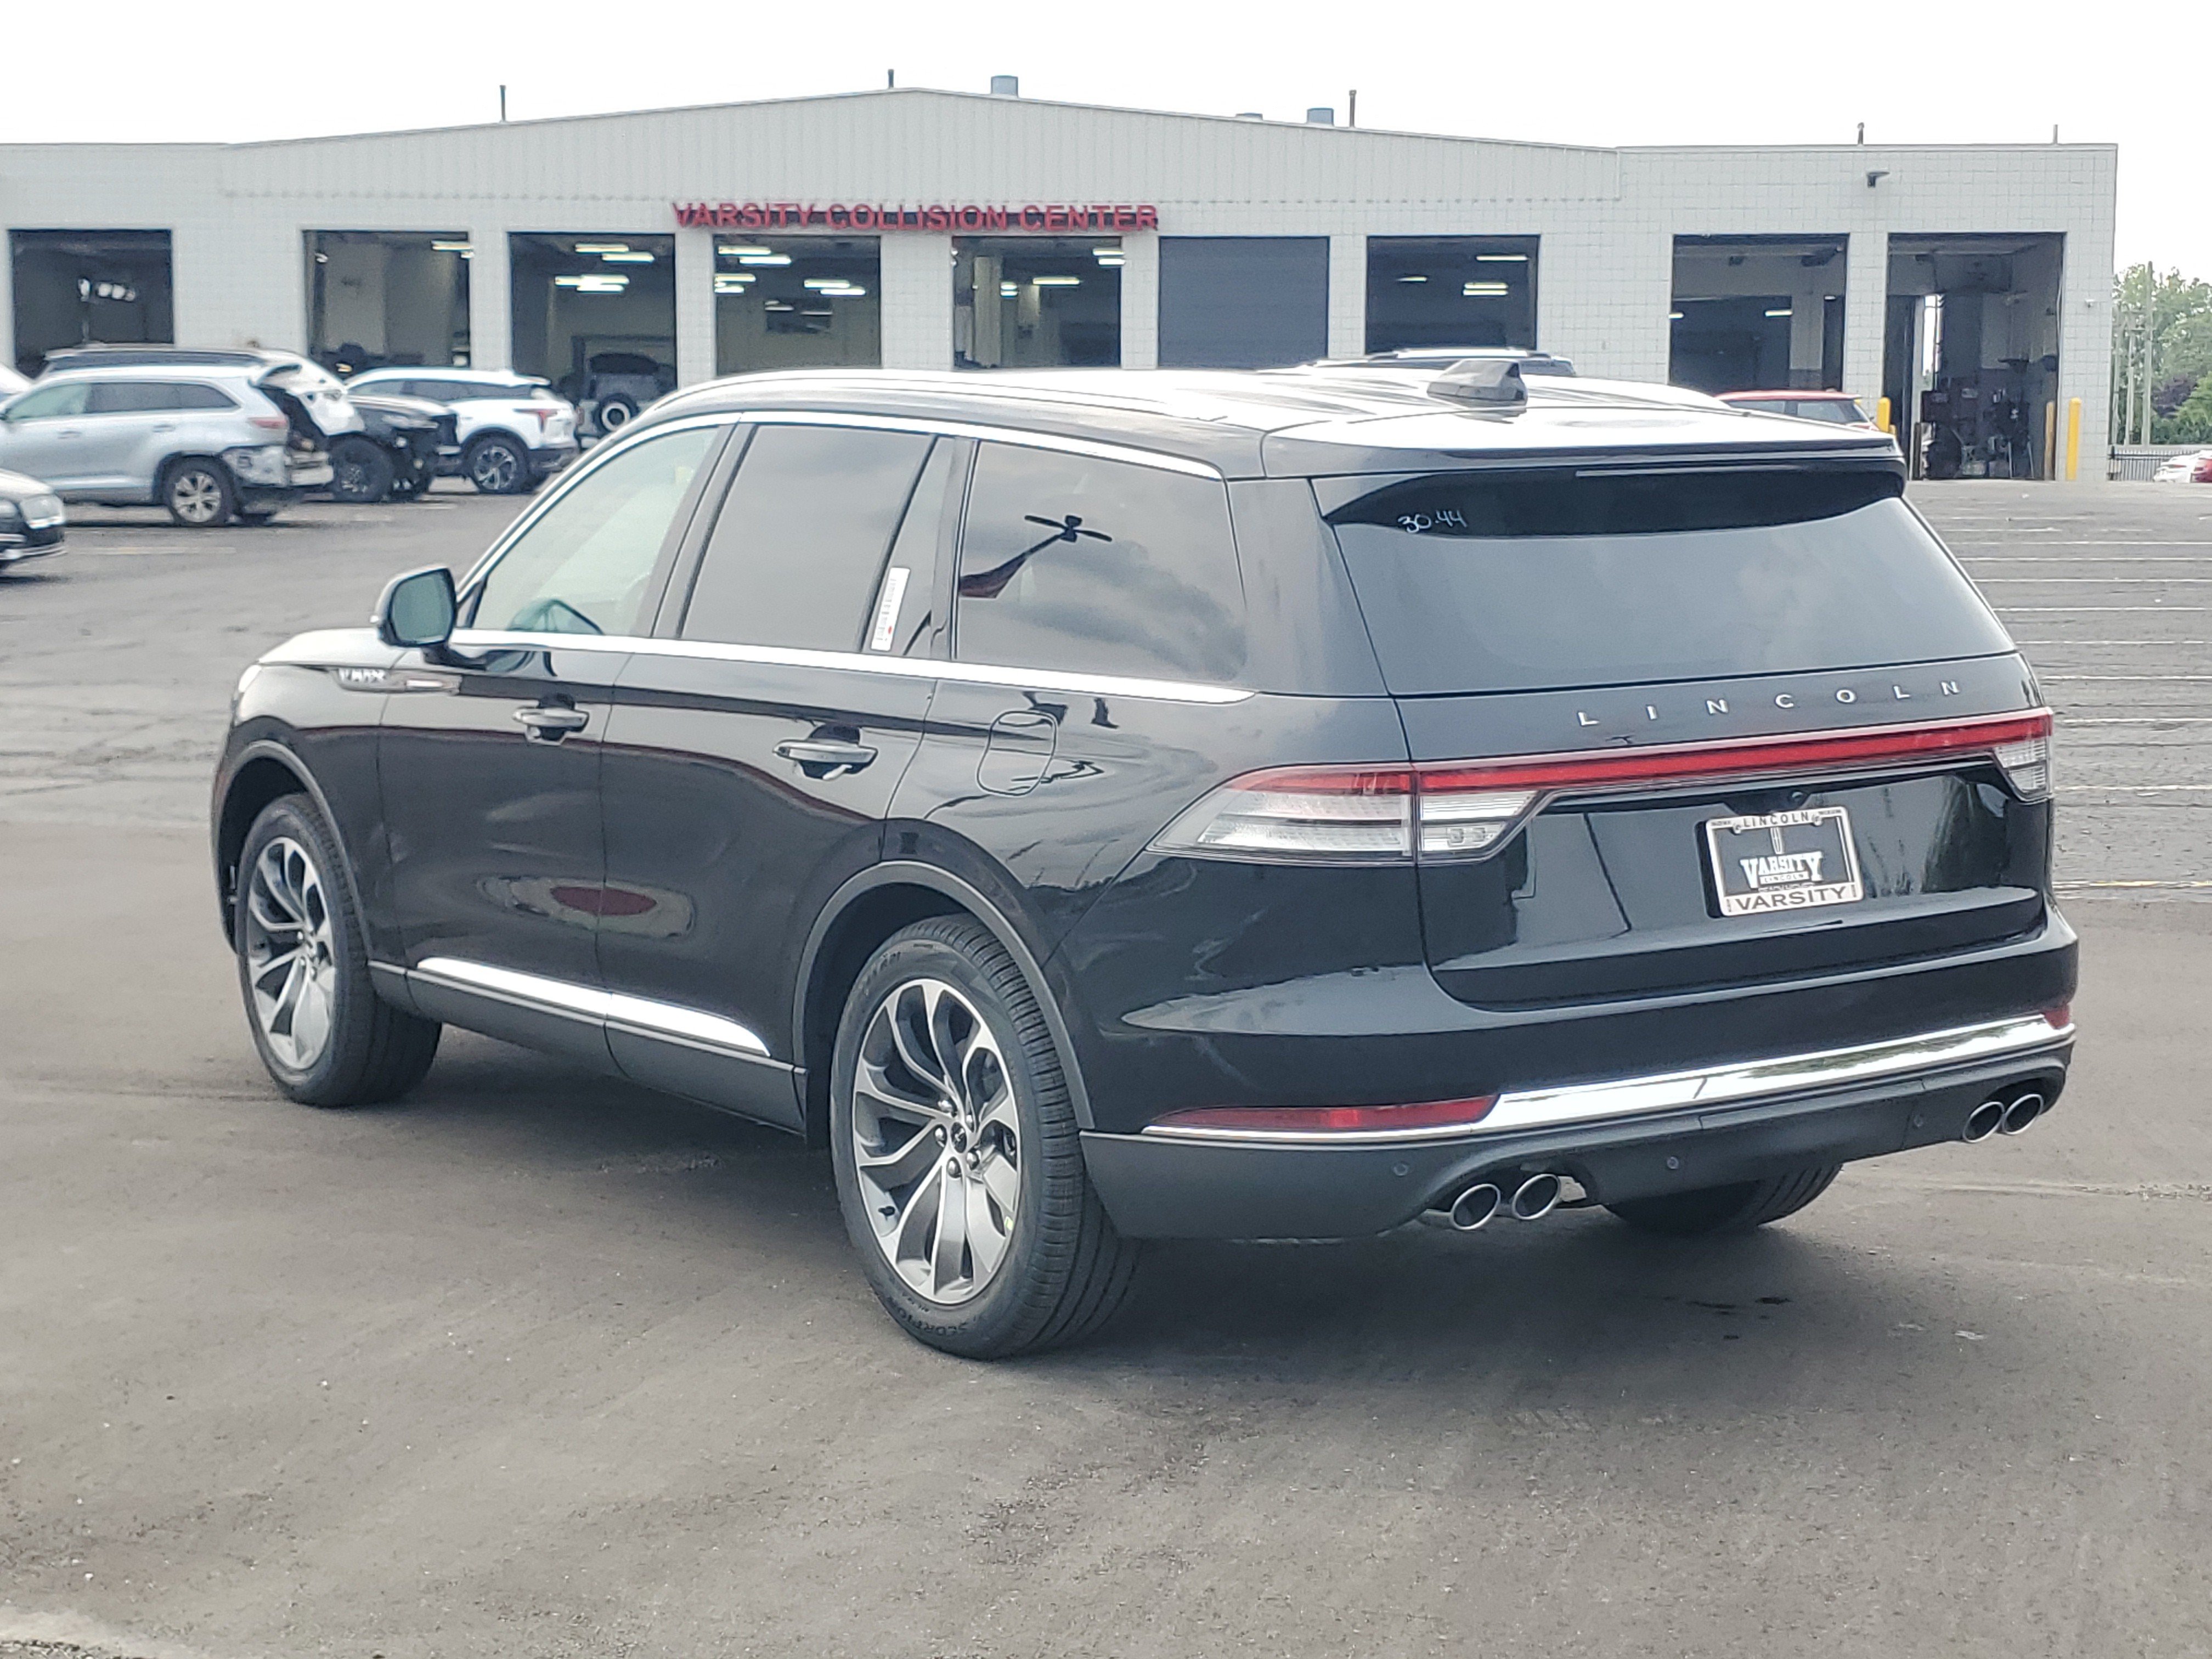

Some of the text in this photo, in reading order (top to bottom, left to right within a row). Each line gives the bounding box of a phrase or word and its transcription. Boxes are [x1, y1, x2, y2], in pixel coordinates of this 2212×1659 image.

[672, 202, 1158, 231] VARSITY COLLISION CENTER
[1577, 680, 1960, 727] LINCOLN
[1743, 811, 1809, 827] LINCOLN
[1740, 851, 1824, 888] VARSITY
[1764, 873, 1804, 883] LINCOLN
[1735, 885, 1847, 911] VARSITY
